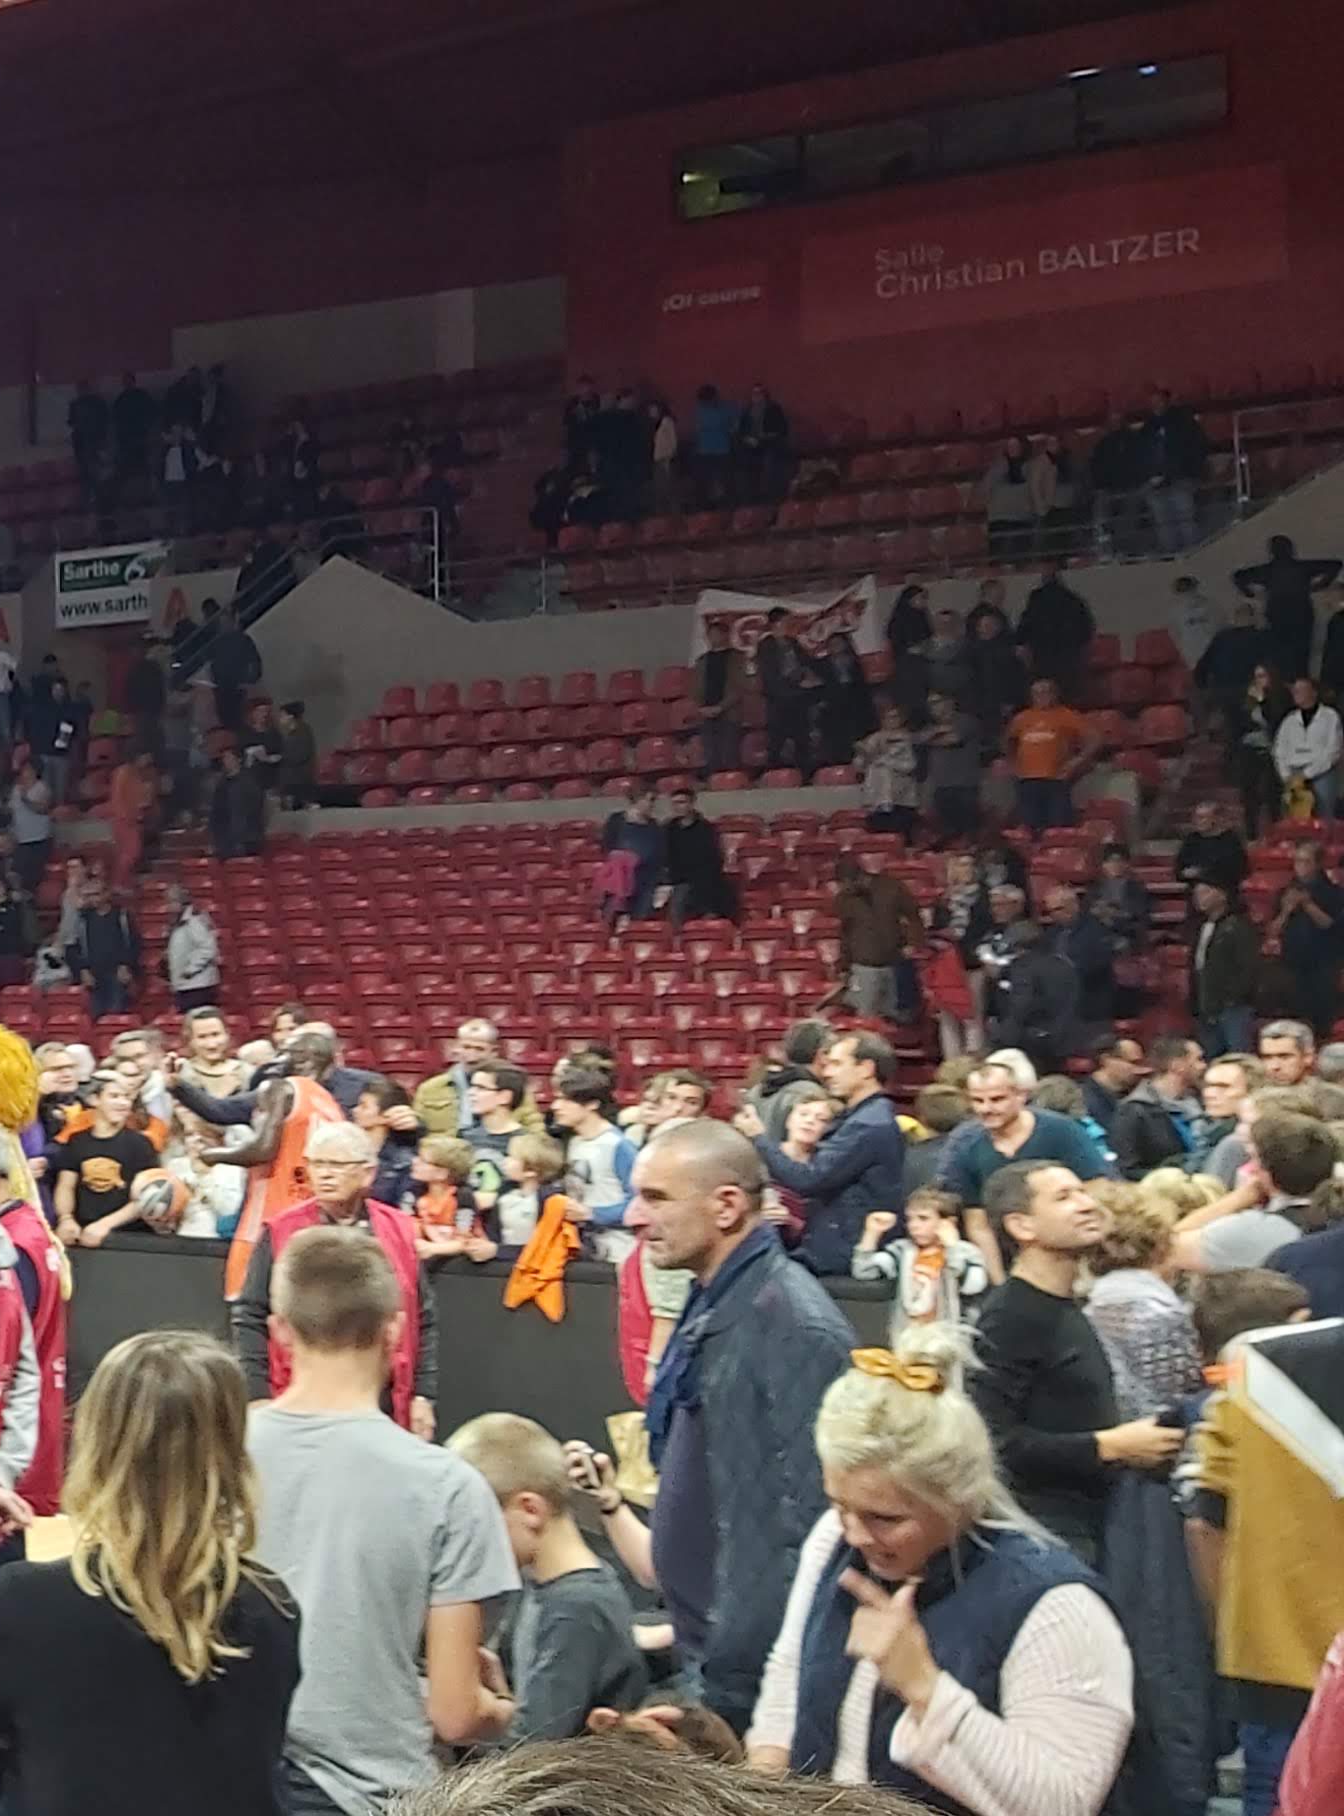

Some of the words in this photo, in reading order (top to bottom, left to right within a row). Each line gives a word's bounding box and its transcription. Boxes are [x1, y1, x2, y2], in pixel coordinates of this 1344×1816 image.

[875, 241, 944, 272] Salle
[875, 257, 1025, 299] Christian
[1038, 226, 1201, 274] BALTZER
[63, 559, 120, 582] Sarthe
